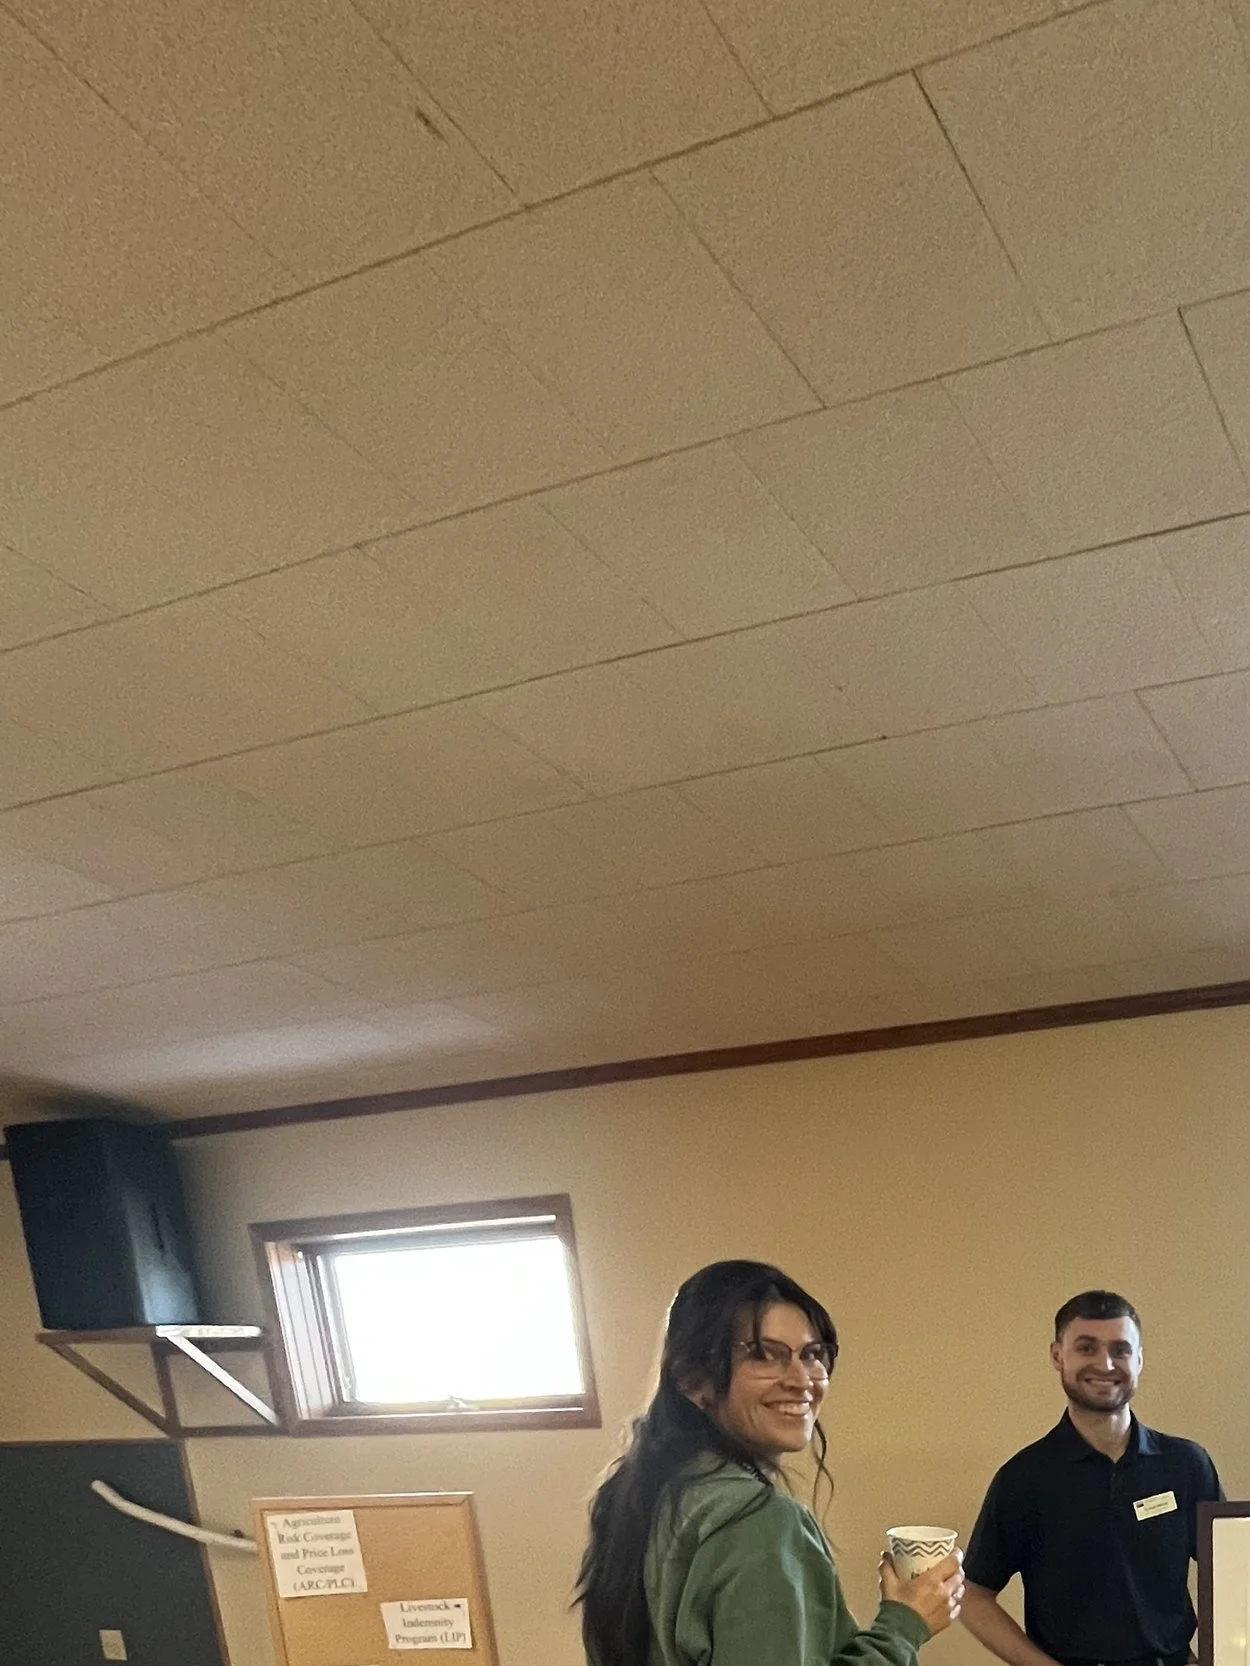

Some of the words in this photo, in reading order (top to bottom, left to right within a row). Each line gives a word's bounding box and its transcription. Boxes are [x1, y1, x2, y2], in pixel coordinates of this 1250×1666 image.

[278, 1532, 300, 1544] Risk
[303, 1531, 353, 1542] Coverage
[281, 1549, 299, 1560] and
[302, 1548, 328, 1559] Price
[330, 1546, 355, 1557] Loss
[297, 1564, 345, 1576] Coverage
[400, 1601, 450, 1612] Livestock
[402, 1618, 454, 1629] Indemnity
[395, 1633, 437, 1645] Program
